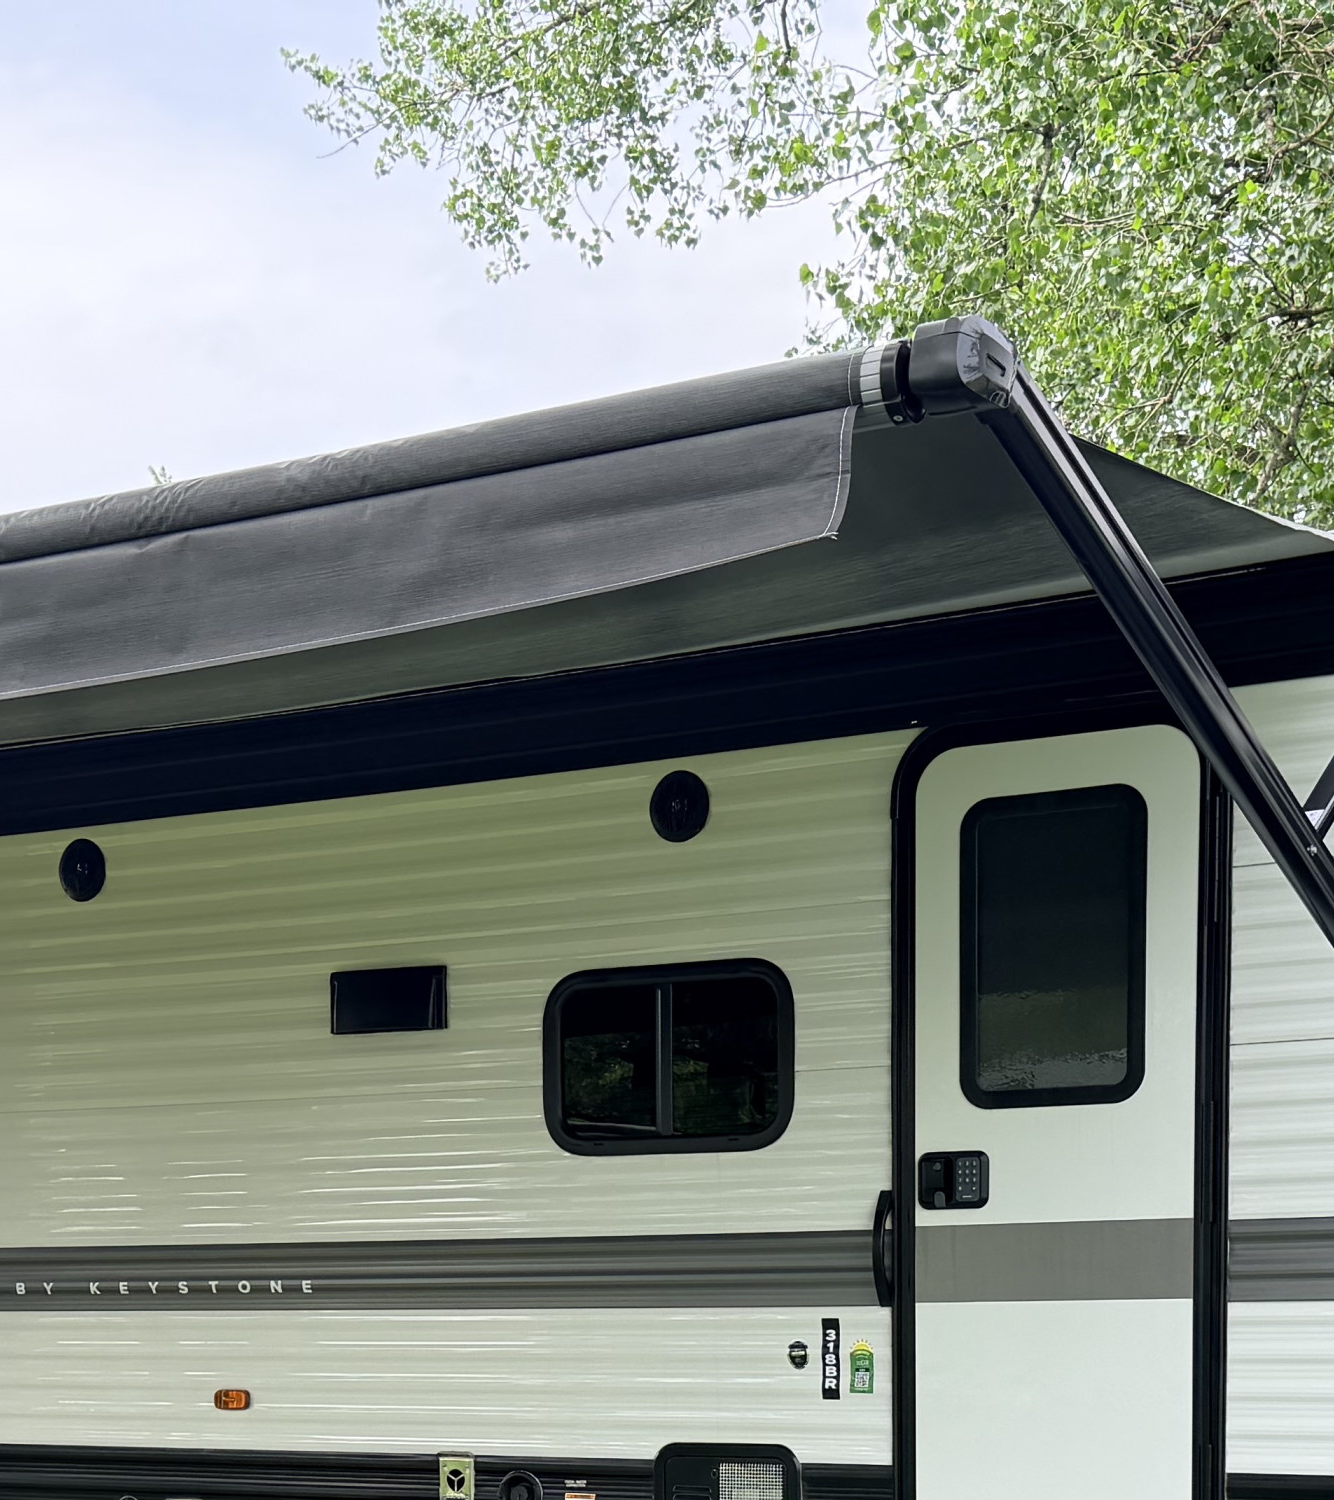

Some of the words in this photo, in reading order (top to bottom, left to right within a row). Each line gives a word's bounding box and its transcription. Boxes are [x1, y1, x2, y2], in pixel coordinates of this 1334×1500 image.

[15, 1282, 54, 1295] BY
[89, 1280, 313, 1295] KEYSTONE
[824, 1329, 838, 1389] 318BR
